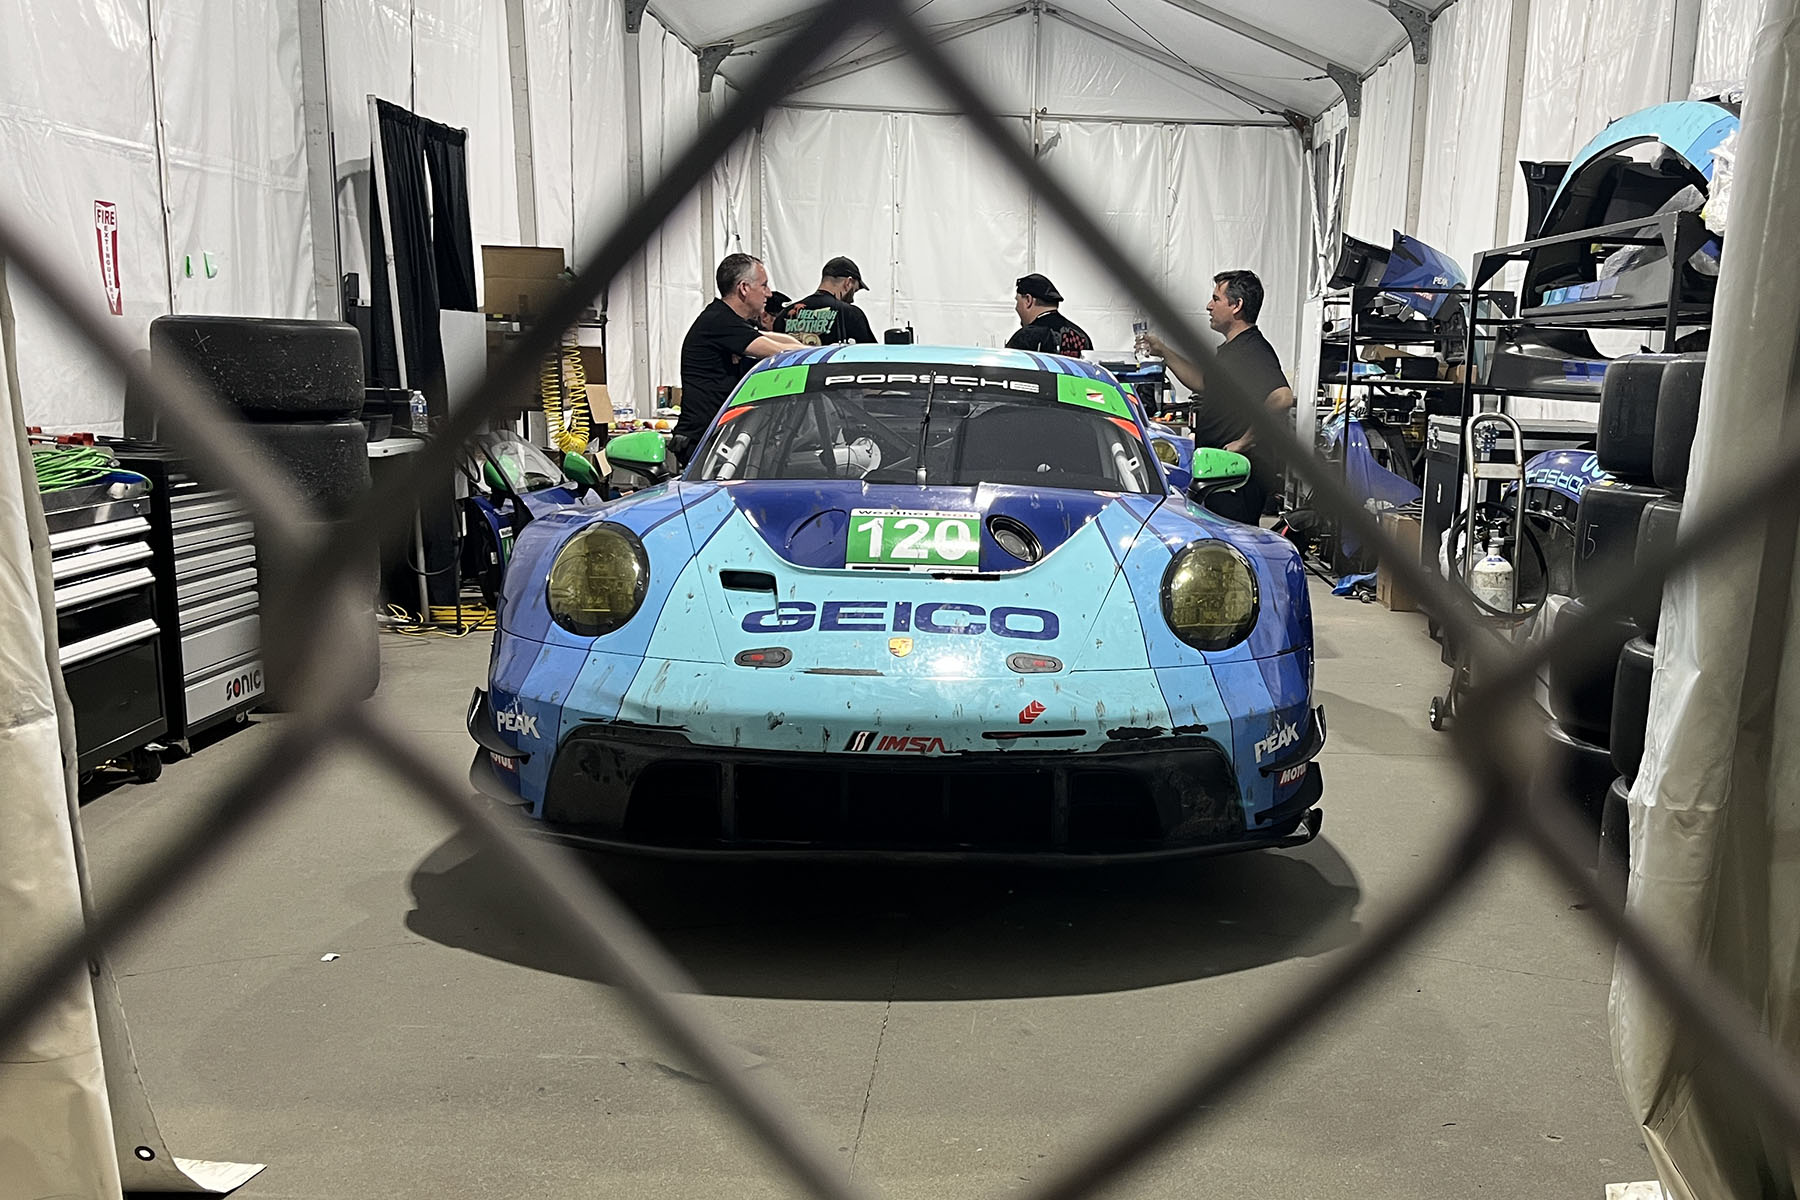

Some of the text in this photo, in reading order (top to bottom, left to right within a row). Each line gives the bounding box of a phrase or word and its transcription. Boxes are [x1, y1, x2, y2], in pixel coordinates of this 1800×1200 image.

[97, 209, 115, 225] FIRE
[784, 319, 834, 334] BROTHER!
[825, 374, 1040, 393] PORSCHE
[1525, 469, 1585, 495] ORSCH
[857, 517, 971, 561] 120
[741, 601, 1060, 641] GEICO
[497, 710, 541, 739] PEAK
[876, 735, 946, 752] IMSA
[1254, 721, 1300, 764] PEAK
[1280, 762, 1308, 785] MOTU
